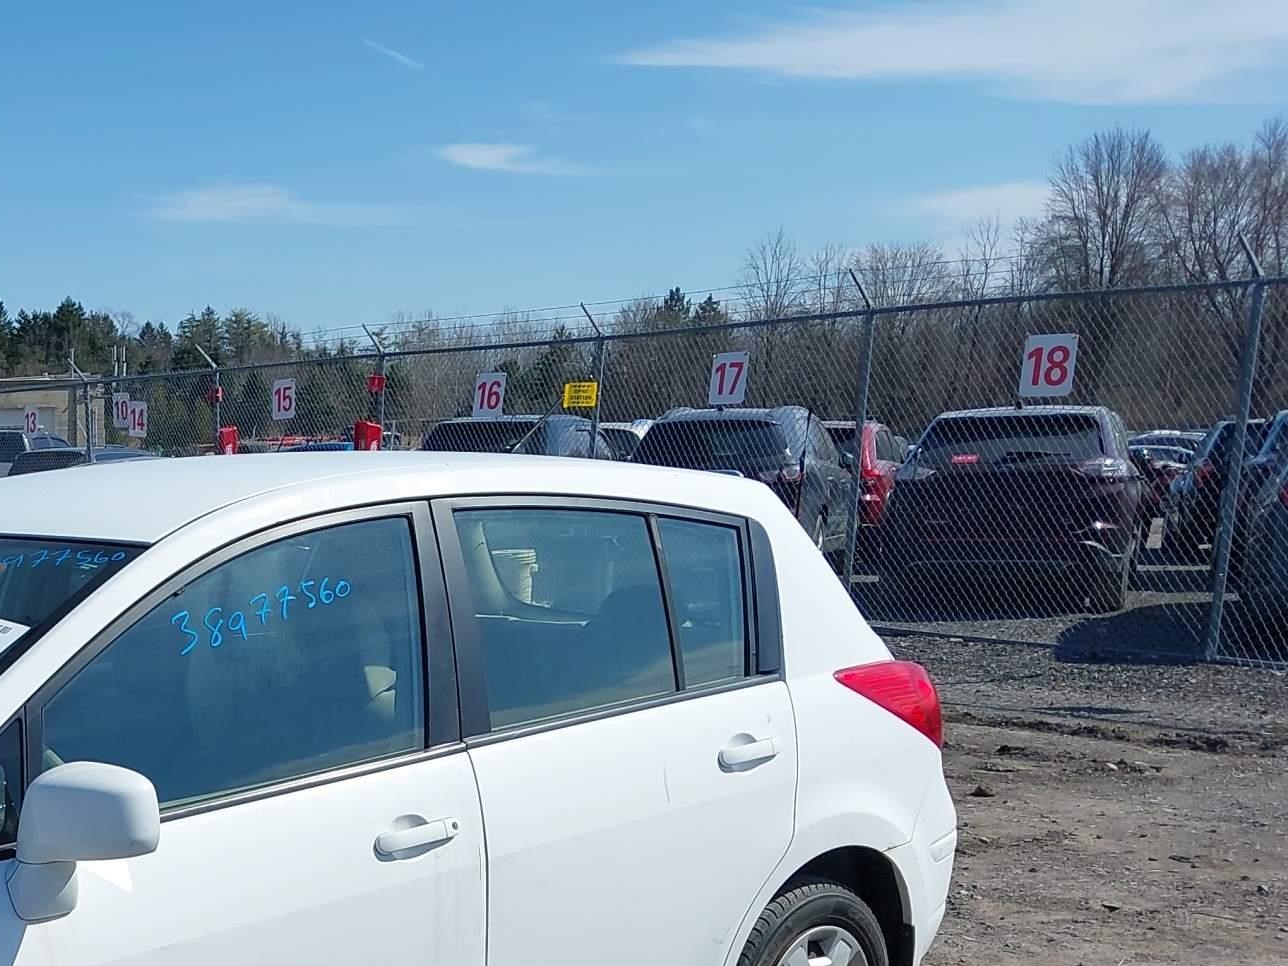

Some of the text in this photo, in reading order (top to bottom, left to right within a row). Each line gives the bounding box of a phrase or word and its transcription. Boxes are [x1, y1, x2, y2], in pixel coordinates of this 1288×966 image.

[715, 361, 745, 395] 17
[1027, 345, 1070, 387] 18
[275, 386, 292, 412] 15
[478, 380, 501, 410] 16
[24, 412, 37, 433] 13
[114, 405, 128, 421] 10
[130, 412, 145, 431] 14
[171, 577, 351, 656] 38977560
